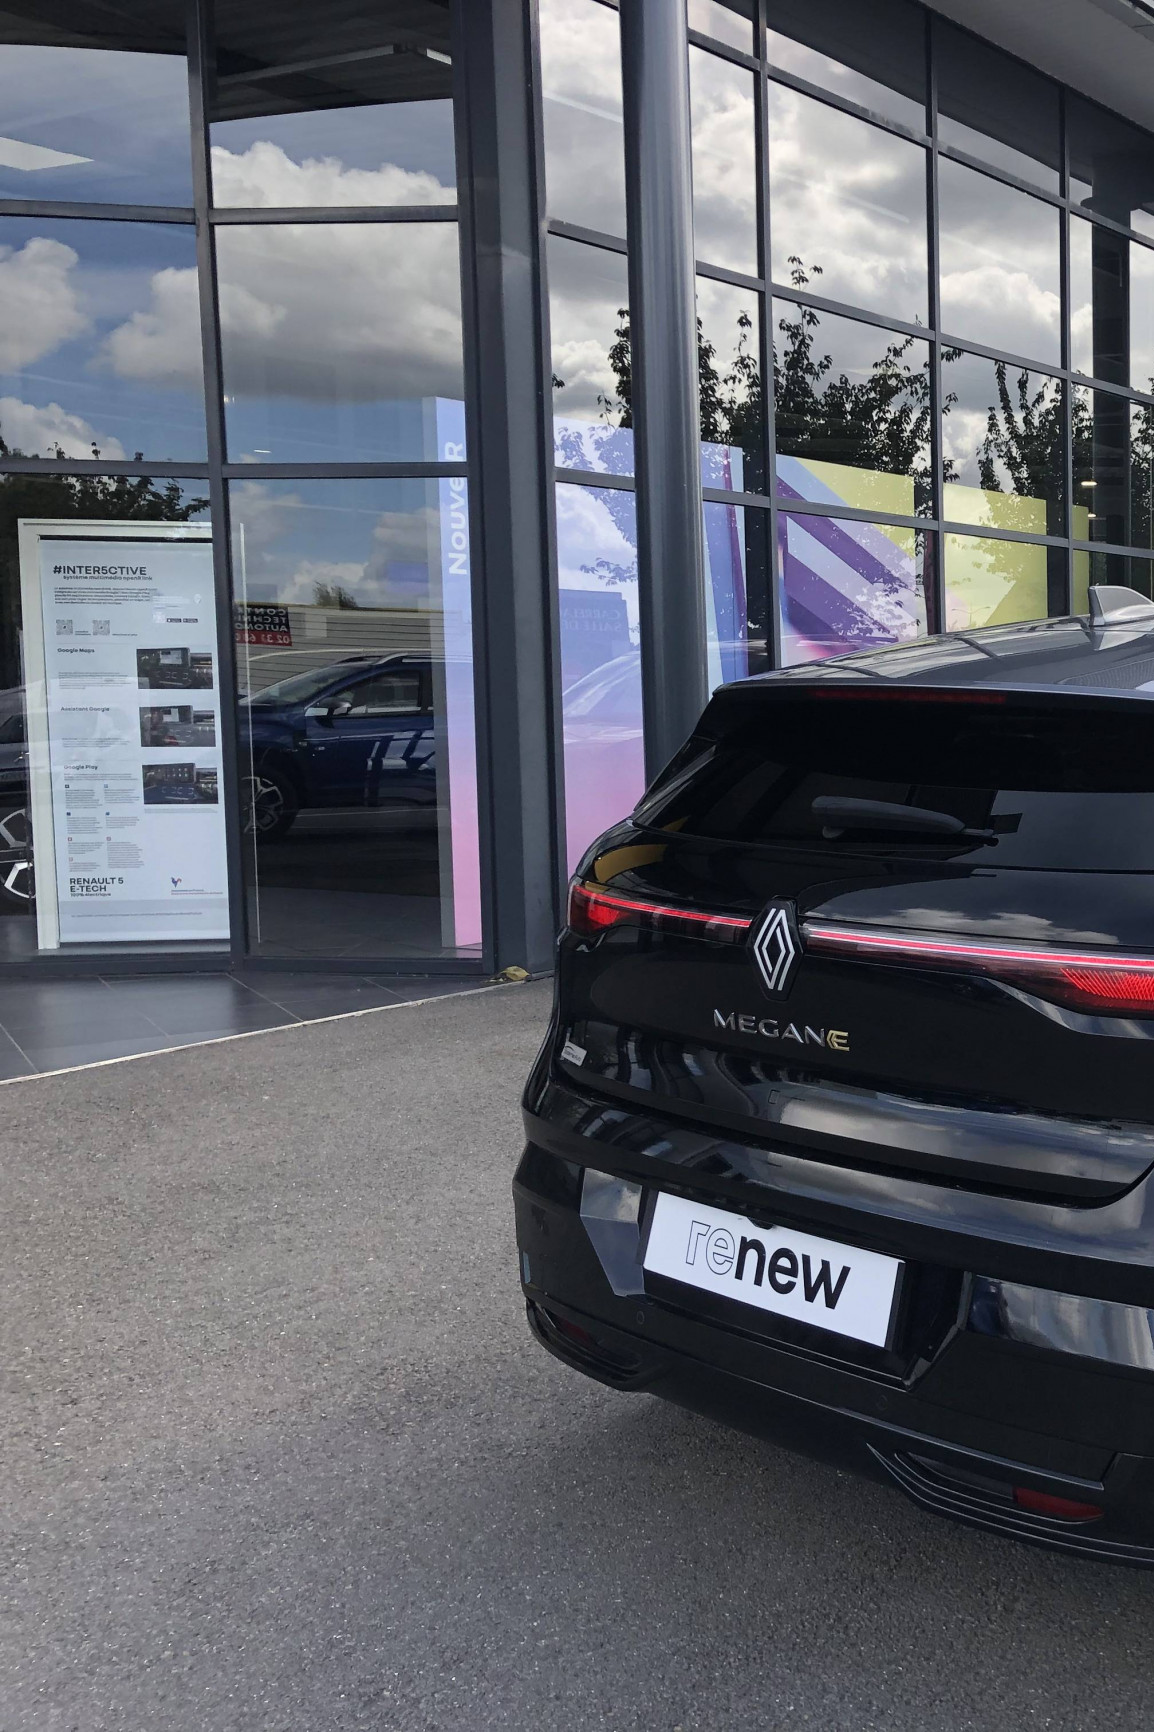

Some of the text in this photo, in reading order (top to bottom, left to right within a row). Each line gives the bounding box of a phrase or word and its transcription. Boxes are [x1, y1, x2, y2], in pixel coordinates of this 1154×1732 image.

[53, 565, 147, 576] #INTER5CTIVE
[70, 877, 124, 885] RENAULT 5
[70, 885, 107, 893] E-TECH
[713, 1008, 850, 1052] MEGANE
[685, 1220, 851, 1310] renew
